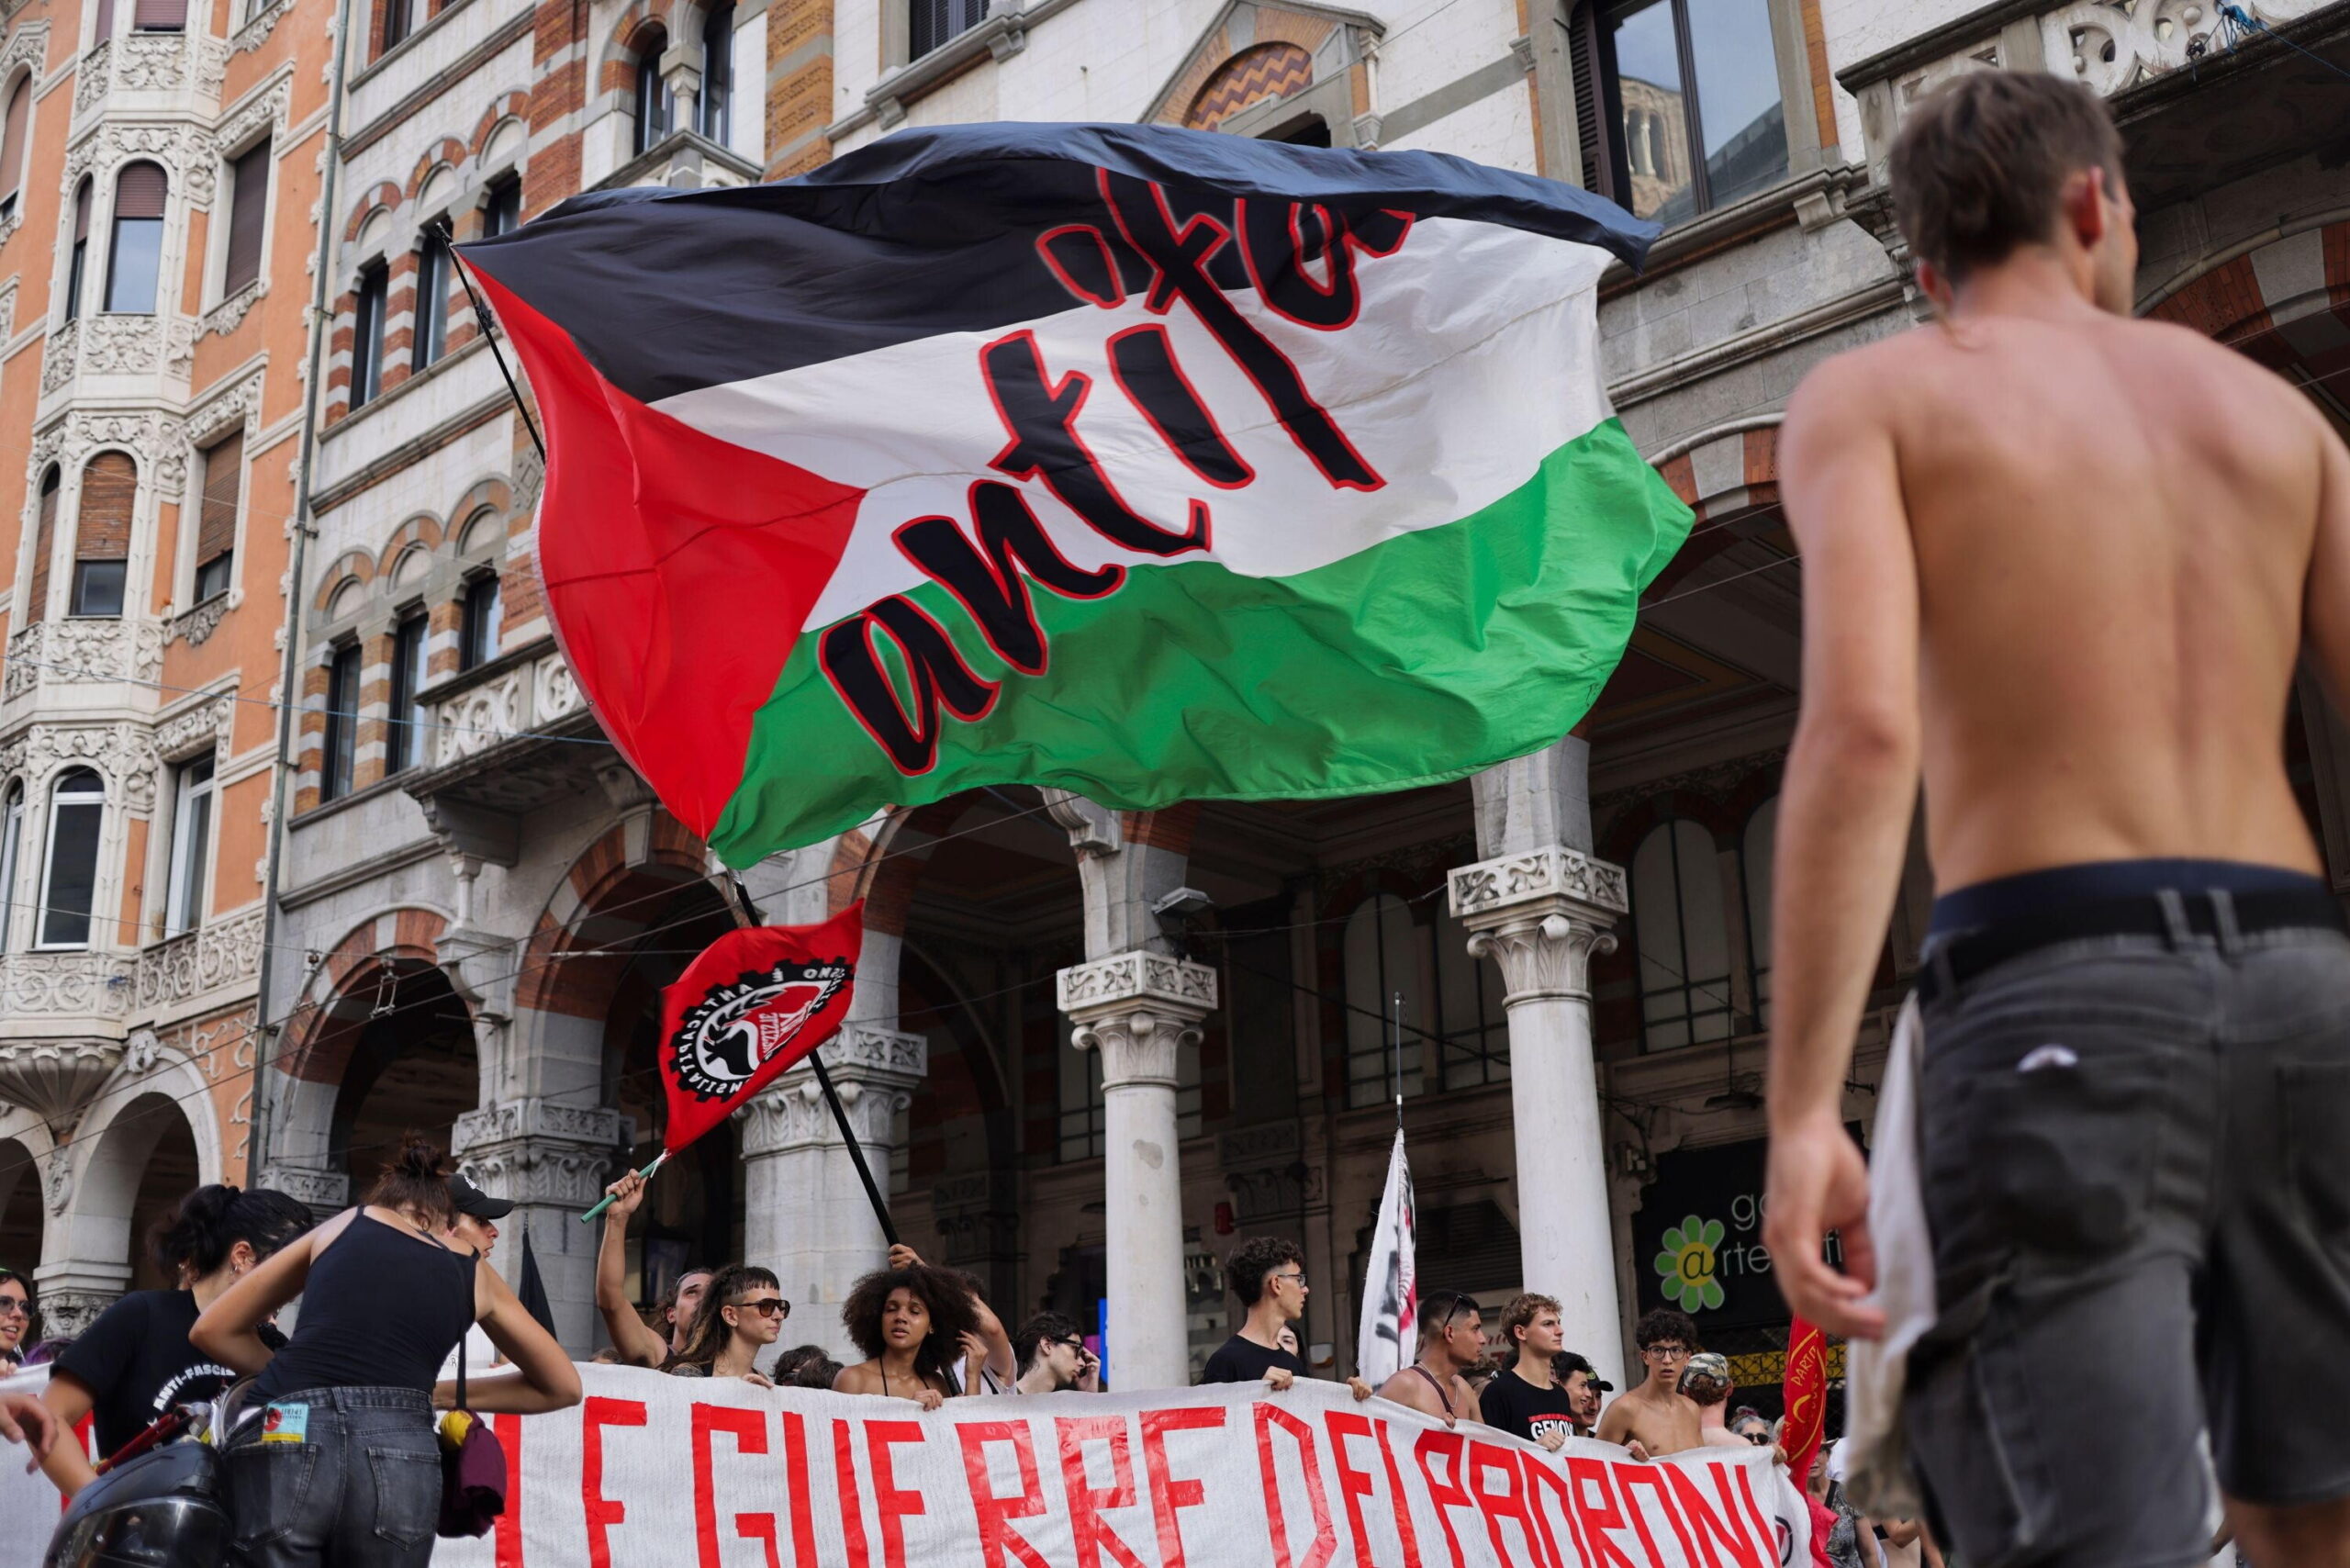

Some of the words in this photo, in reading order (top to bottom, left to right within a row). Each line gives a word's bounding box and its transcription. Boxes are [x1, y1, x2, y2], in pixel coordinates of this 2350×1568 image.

[817, 165, 1416, 778] antifa
[691, 1402, 1226, 1568] GUERRE
[1252, 1402, 1422, 1568] DEI
[1414, 1428, 1783, 1568] PADRONI
